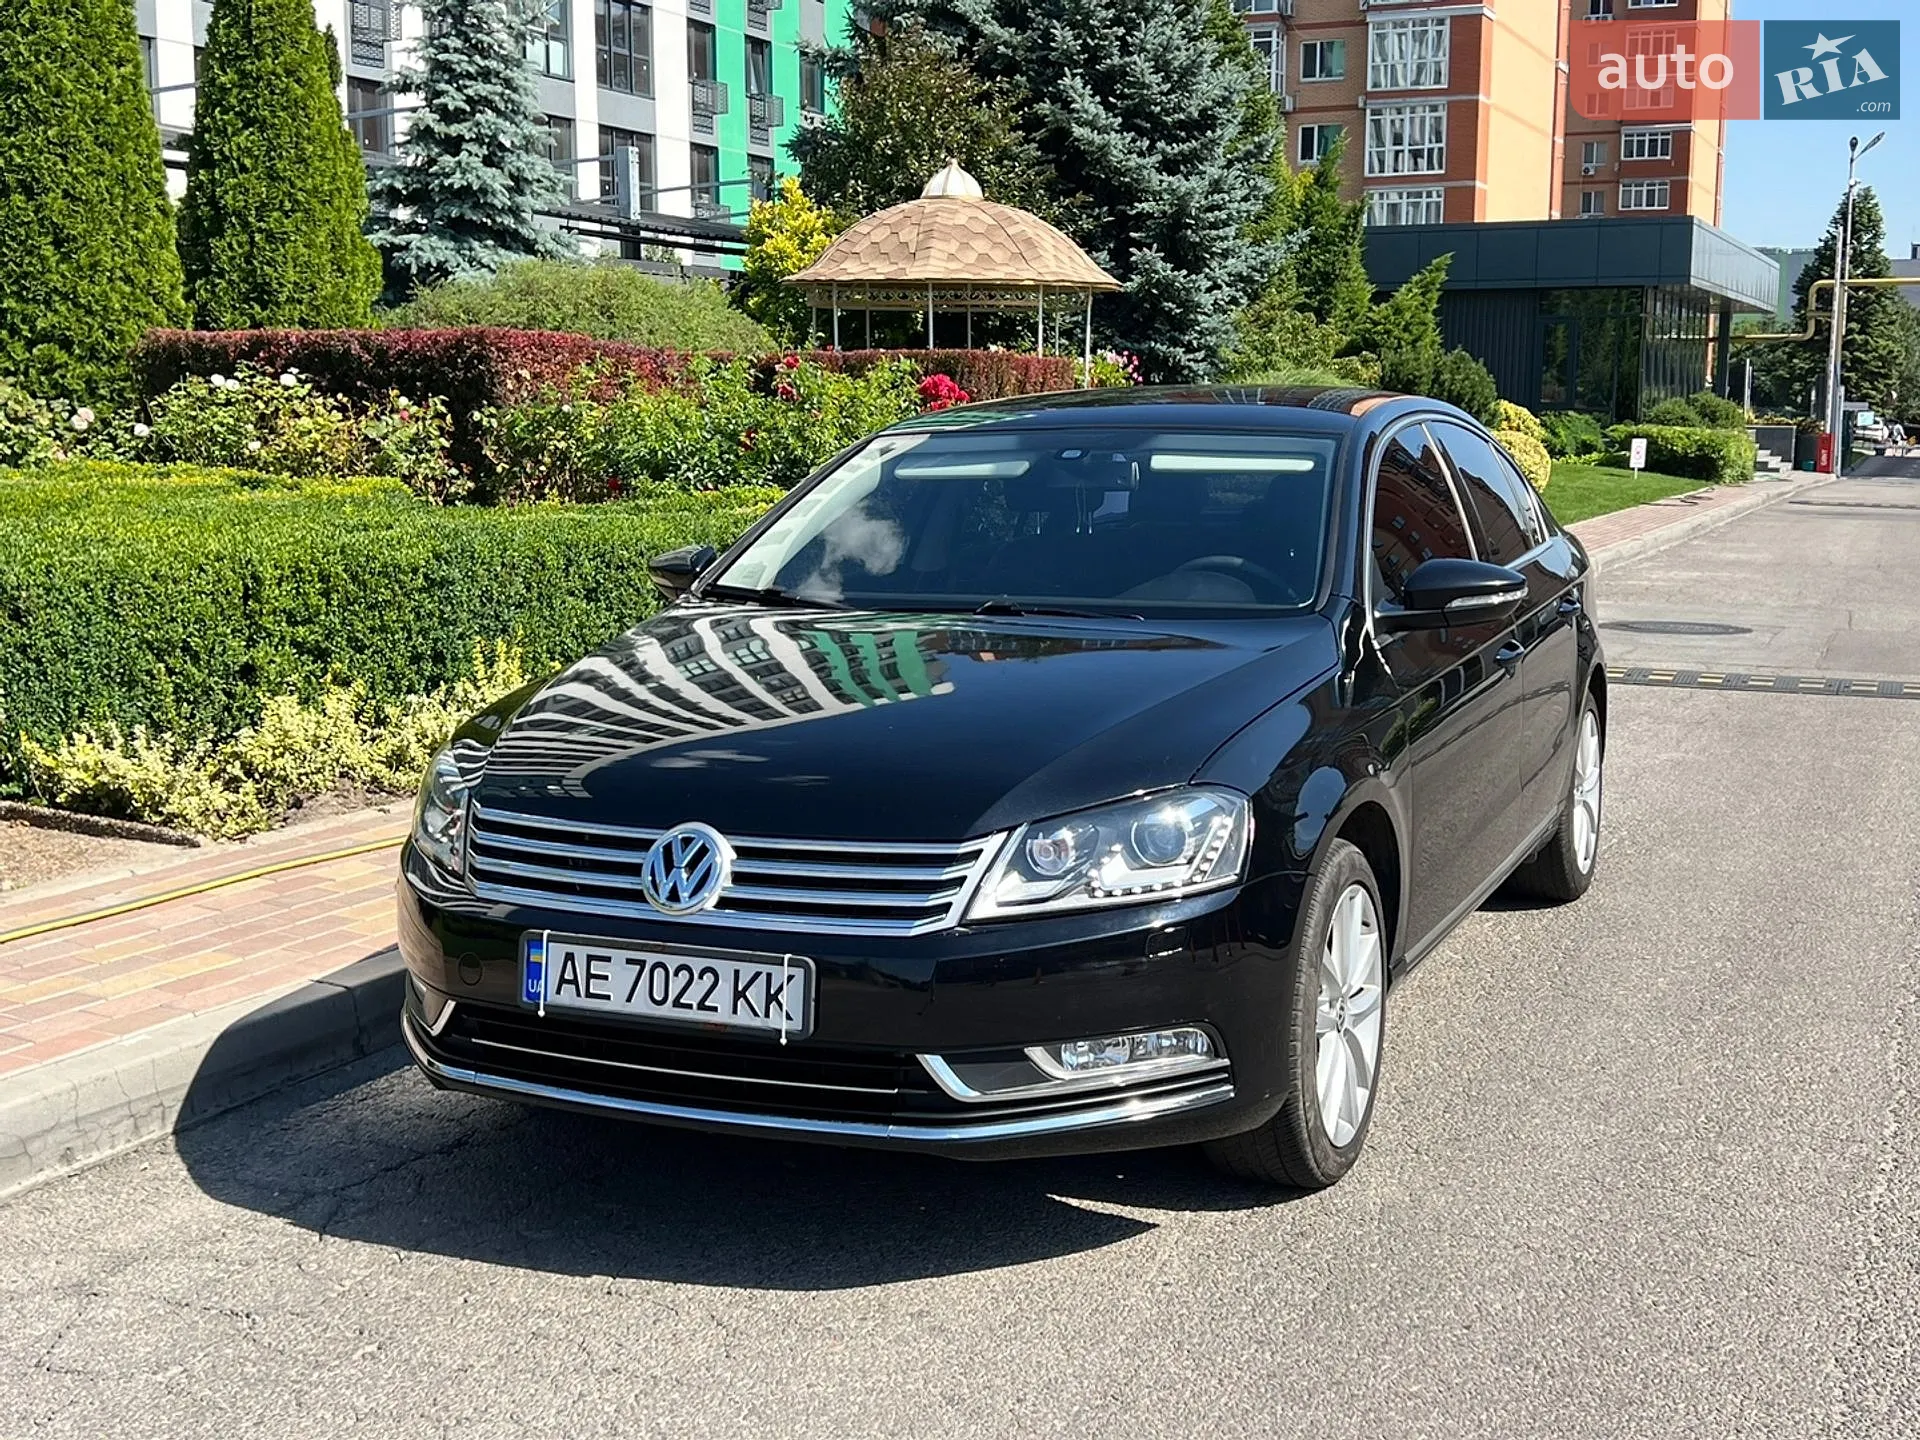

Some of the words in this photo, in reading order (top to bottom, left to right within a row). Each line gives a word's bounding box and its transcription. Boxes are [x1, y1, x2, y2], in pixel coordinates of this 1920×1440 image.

[555, 951, 612, 1001] AE
[624, 957, 720, 1013] 7022
[732, 968, 796, 1022] KK
